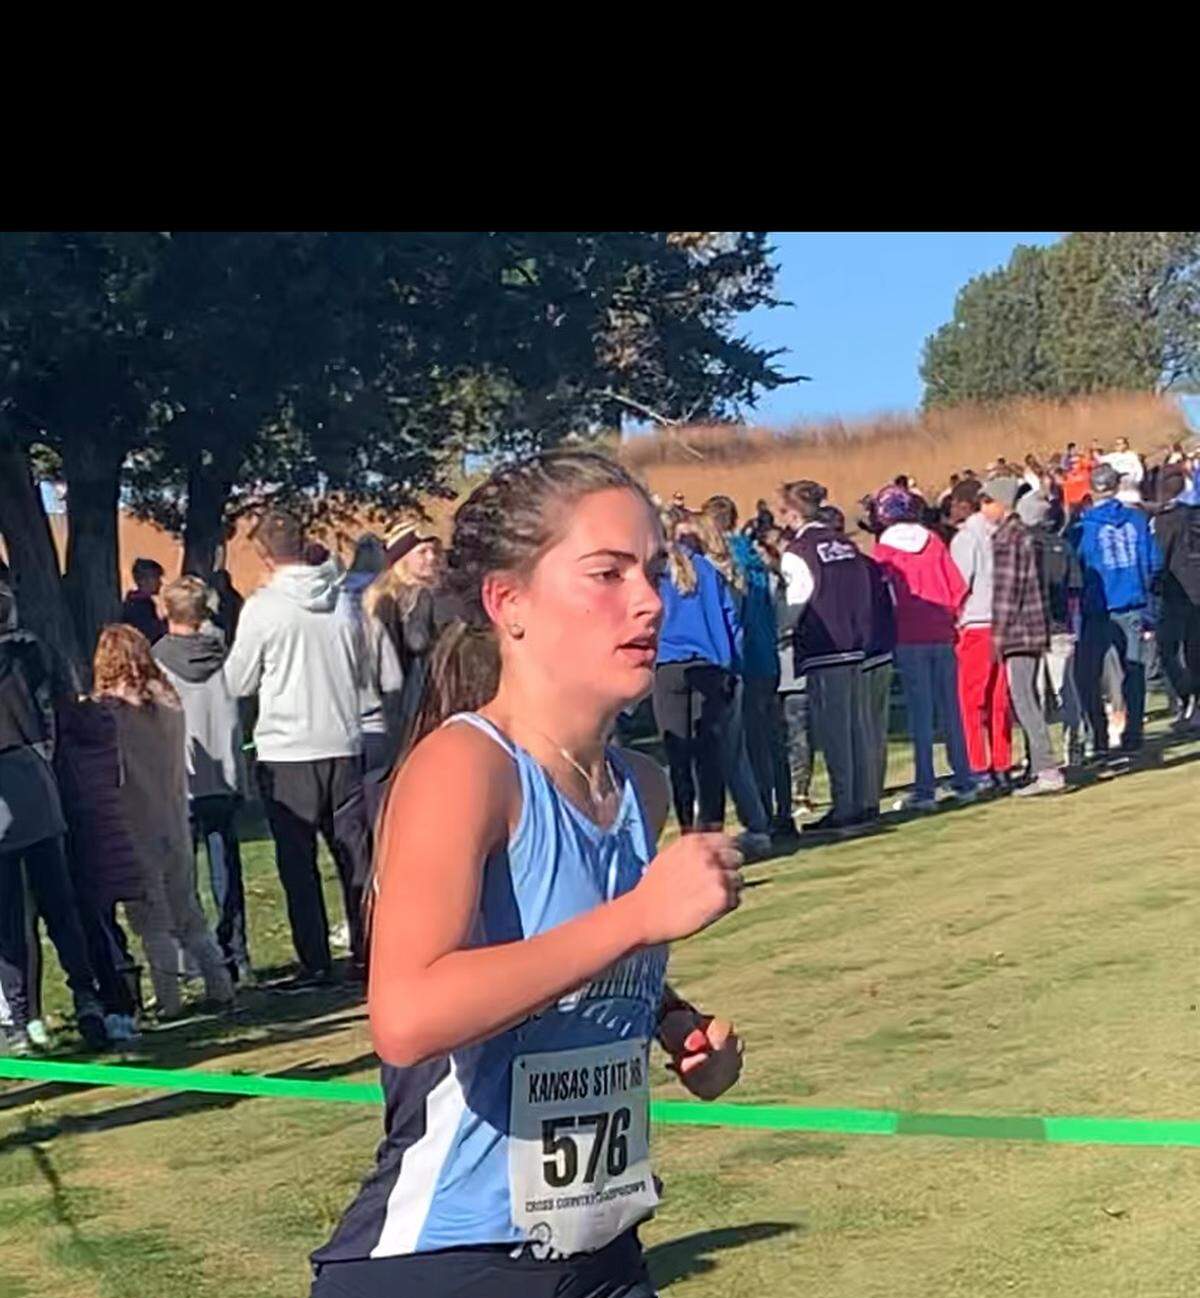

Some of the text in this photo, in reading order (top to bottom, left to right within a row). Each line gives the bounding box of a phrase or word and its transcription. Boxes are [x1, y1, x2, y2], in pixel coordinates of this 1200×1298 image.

[528, 1067, 589, 1103] KANSAS
[593, 1061, 628, 1096] STATE
[541, 1107, 631, 1187] 576
